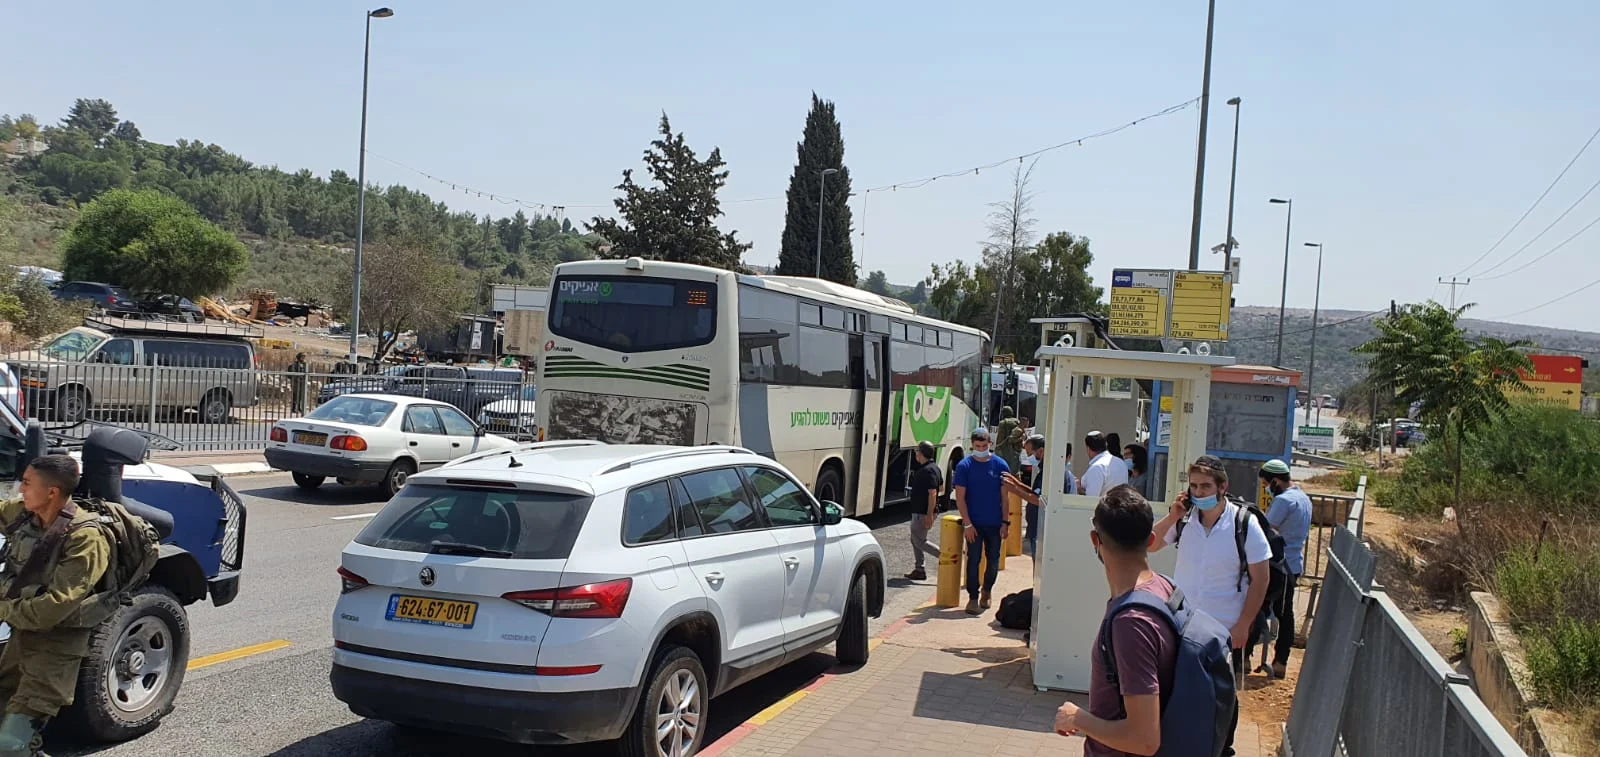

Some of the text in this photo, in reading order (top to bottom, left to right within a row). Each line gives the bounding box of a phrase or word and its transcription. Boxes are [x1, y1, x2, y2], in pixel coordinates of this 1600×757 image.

[559, 280, 599, 295] אפיקים
[790, 407, 855, 430] אפיקים פשוט להגיע
